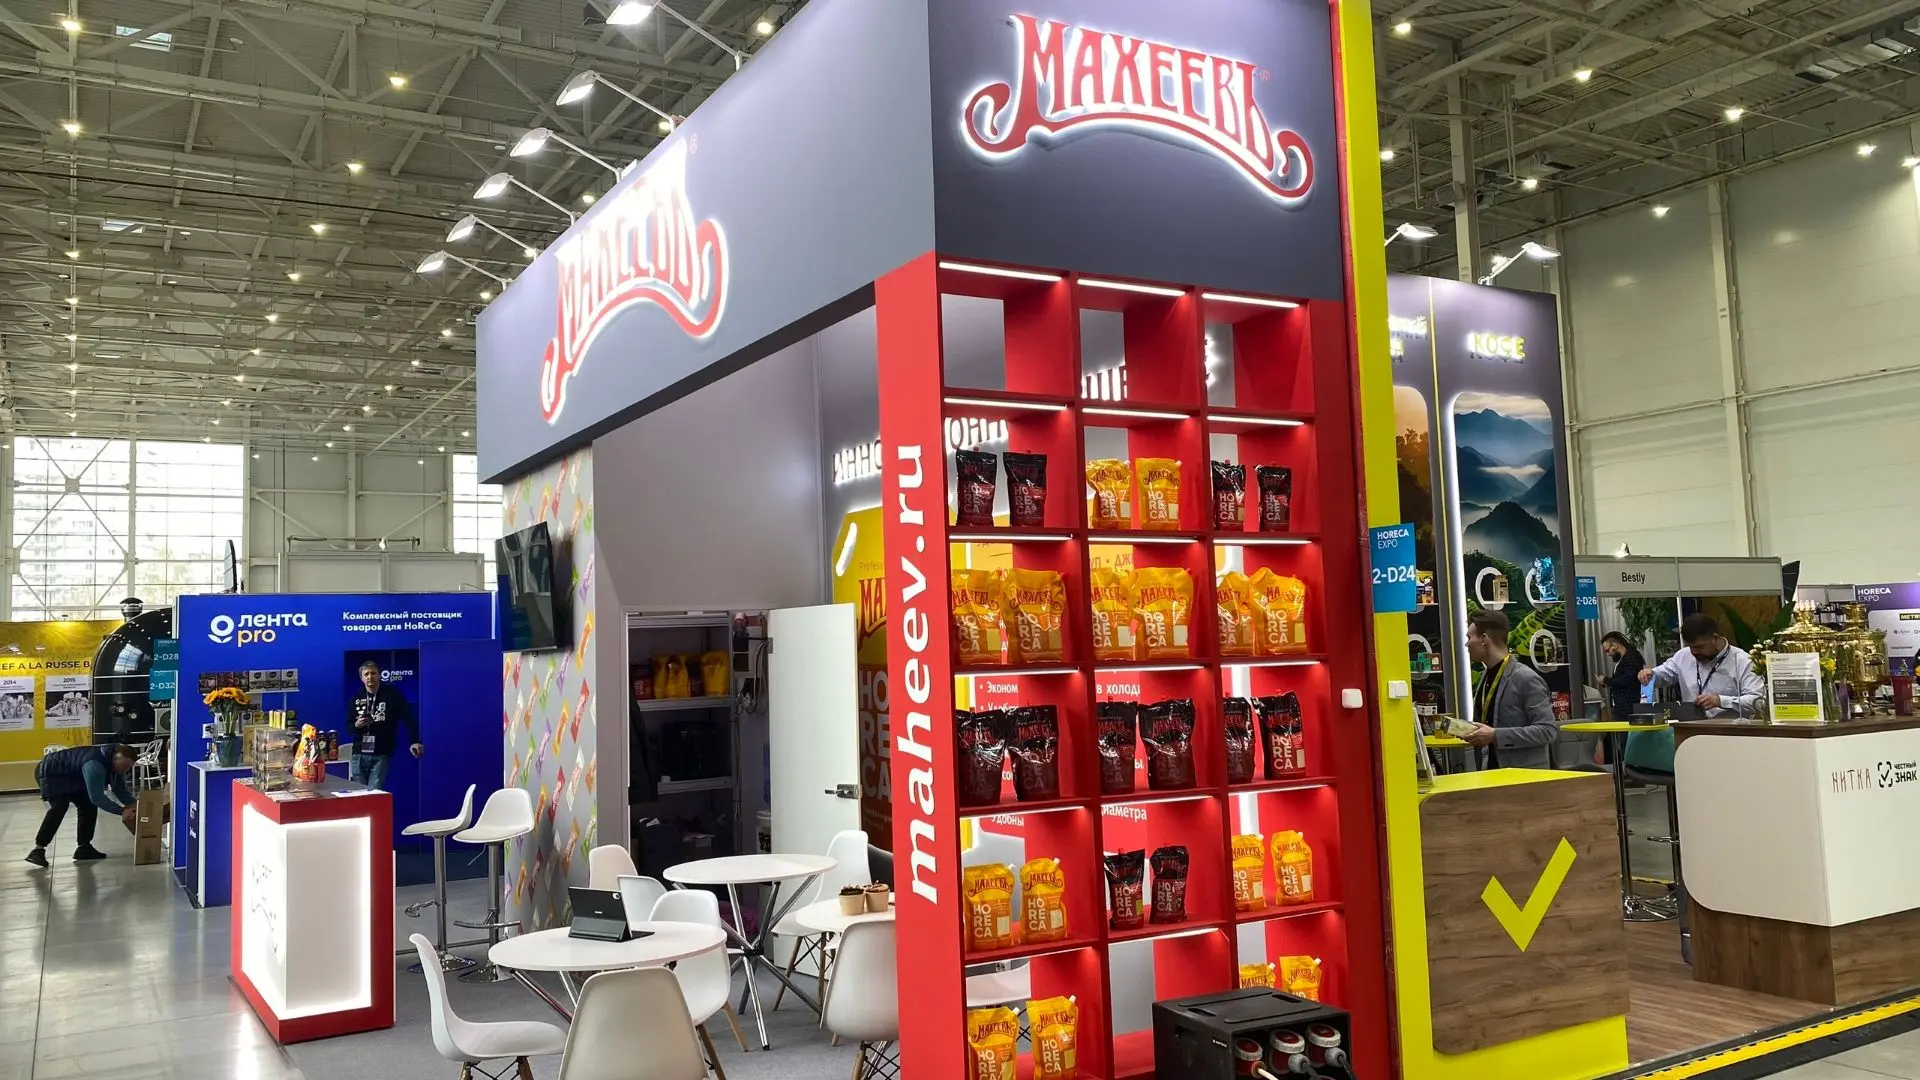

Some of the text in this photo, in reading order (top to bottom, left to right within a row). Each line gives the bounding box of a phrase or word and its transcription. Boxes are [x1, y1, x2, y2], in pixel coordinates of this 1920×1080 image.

[1148, 491, 1164, 500] HO
[1219, 493, 1235, 502] HO
[1101, 499, 1116, 508] RE
[1219, 502, 1235, 511] RE
[1266, 502, 1280, 511] RE
[1101, 509, 1118, 518] CA
[1150, 510, 1167, 519] CA
[1220, 511, 1235, 520] CA
[1266, 512, 1281, 520] CA
[1377, 529, 1409, 540] HORECA
[1378, 539, 1398, 549] EXPO
[1372, 564, 1416, 584] 2-D24
[1576, 596, 1597, 605] 2-D26
[237, 612, 308, 628] лента
[343, 611, 462, 621] Комплексный поставщик
[343, 622, 442, 632] товаров для HoReCa
[1019, 624, 1041, 637] RE
[1092, 622, 1111, 636] RE
[1145, 622, 1167, 635] RE
[1268, 620, 1288, 632] RE
[237, 629, 276, 648] pro
[1093, 636, 1112, 648] CA
[1146, 635, 1167, 647] CA
[1268, 632, 1288, 644] CA
[960, 639, 980, 651] CA
[1020, 638, 1042, 650] CA
[153, 653, 179, 661] 2-D28
[18, 662, 26, 670] A
[28, 661, 43, 670] LA
[45, 660, 80, 669] RUSSE
[896, 445, 938, 905] maheev.ru
[150, 682, 175, 690] 2-D32
[1271, 735, 1290, 746] HO
[1273, 746, 1292, 758] RE
[1273, 758, 1294, 770] CA
[1893, 760, 1917, 770] ЧЕСТНЫЙ
[1894, 770, 1918, 783] ЗНАК
[1280, 865, 1296, 876] HO
[1234, 880, 1249, 890] RE
[1283, 875, 1298, 886] RE
[1115, 887, 1131, 897] HO
[1234, 891, 1250, 900] CA
[1284, 885, 1300, 895] CA
[1027, 897, 1045, 909] HO
[1116, 897, 1132, 908] RE
[973, 903, 991, 915] HO
[1028, 908, 1046, 920] RE
[1117, 908, 1133, 918] CA
[974, 915, 992, 927] RE
[1028, 920, 1047, 931] CA
[974, 927, 993, 938] CA
[1042, 1039, 1058, 1050] HO
[977, 1049, 995, 1061] HO
[1043, 1050, 1060, 1062] RE
[978, 1061, 997, 1073] RE
[1044, 1062, 1062, 1073] CA
